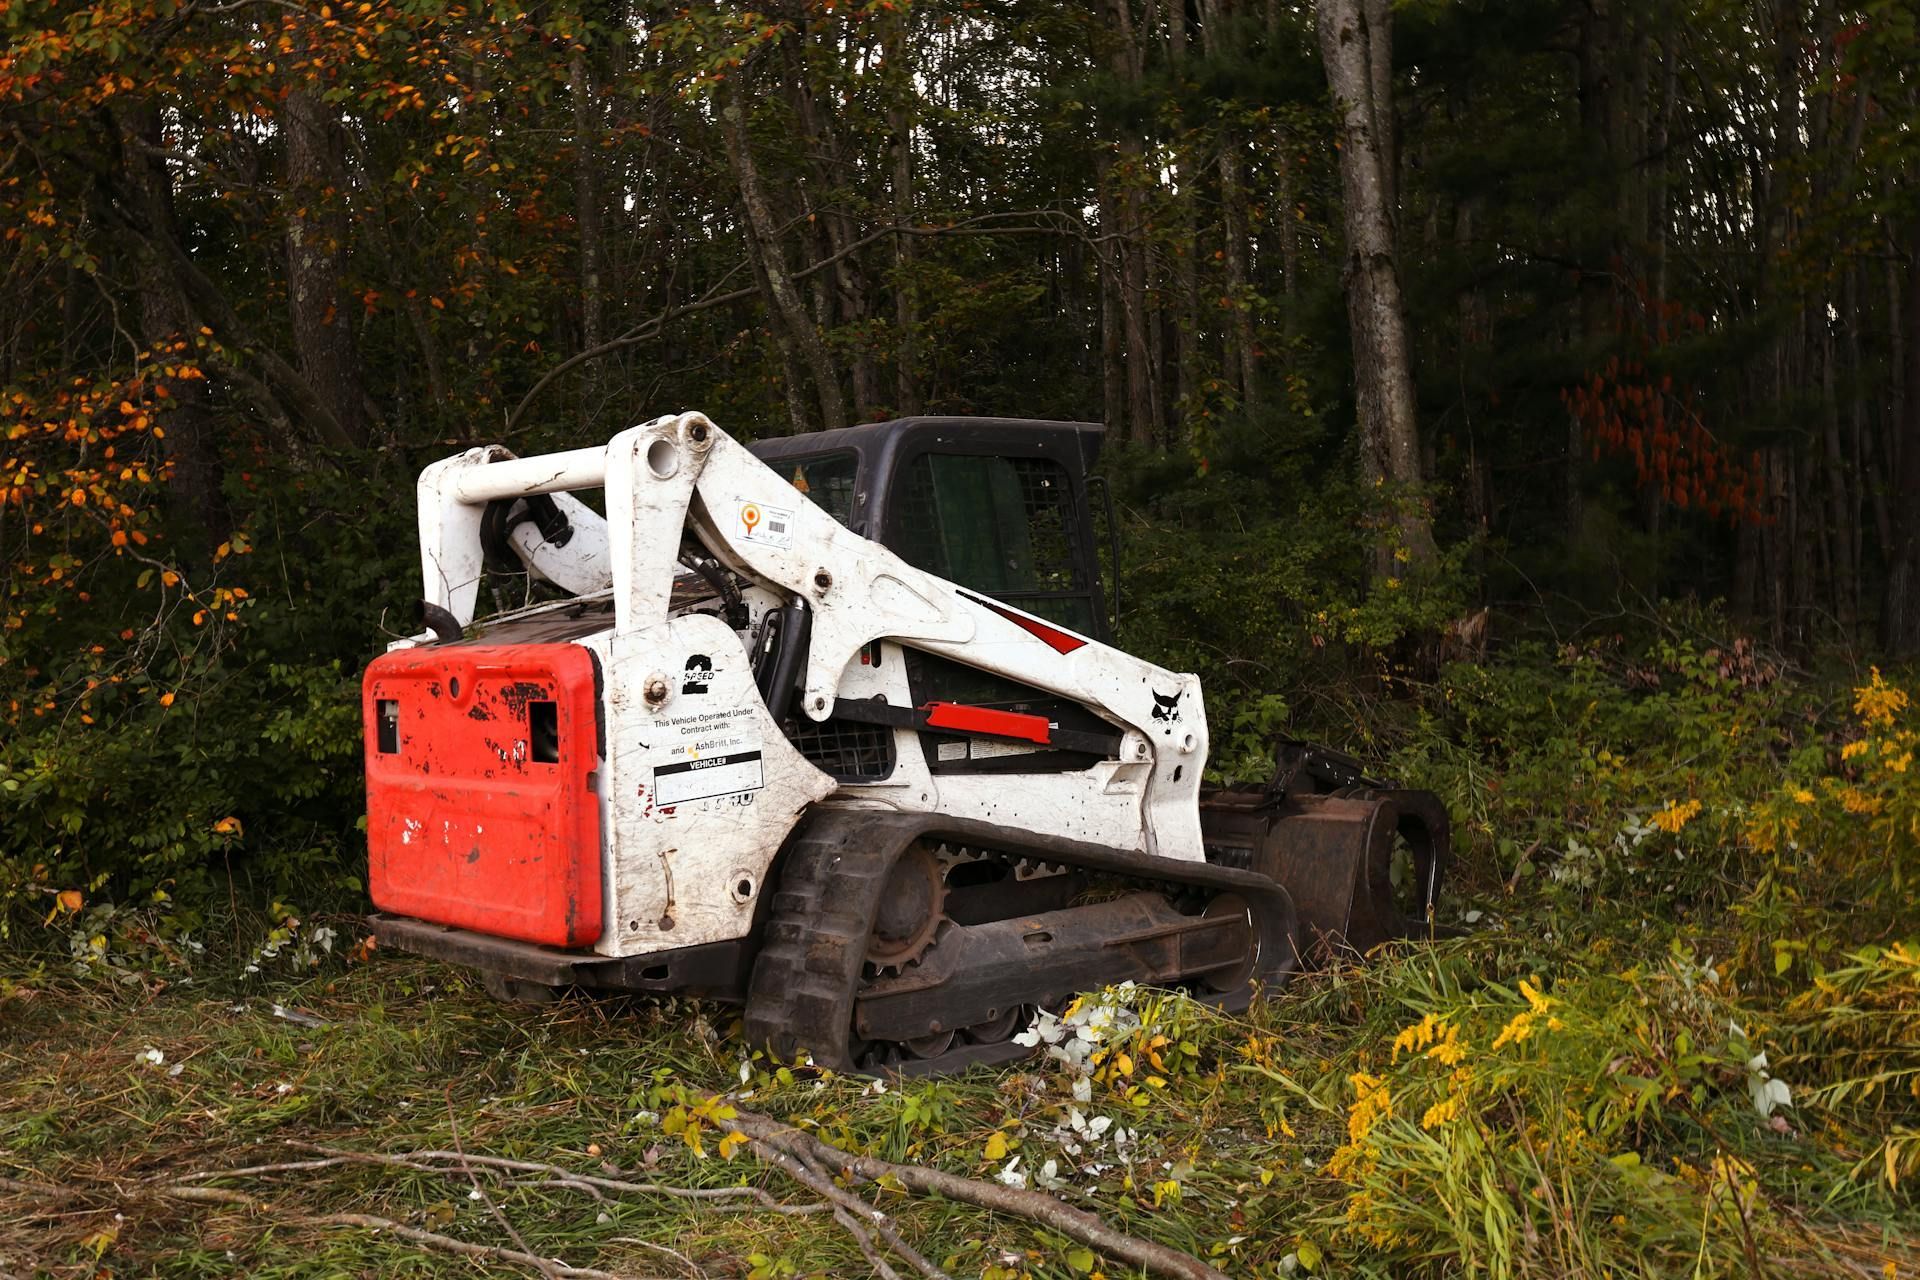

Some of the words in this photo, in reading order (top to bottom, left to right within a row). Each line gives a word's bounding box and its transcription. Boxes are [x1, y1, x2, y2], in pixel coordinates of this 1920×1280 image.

[682, 654, 712, 694] 2
[654, 720, 670, 728] This
[671, 715, 697, 726] Vehicle
[698, 711, 732, 722] Operated
[733, 708, 754, 717] Under
[680, 723, 713, 735] Contract
[713, 721, 731, 731] with:
[671, 746, 685, 755] and
[729, 737, 743, 746] Inc.
